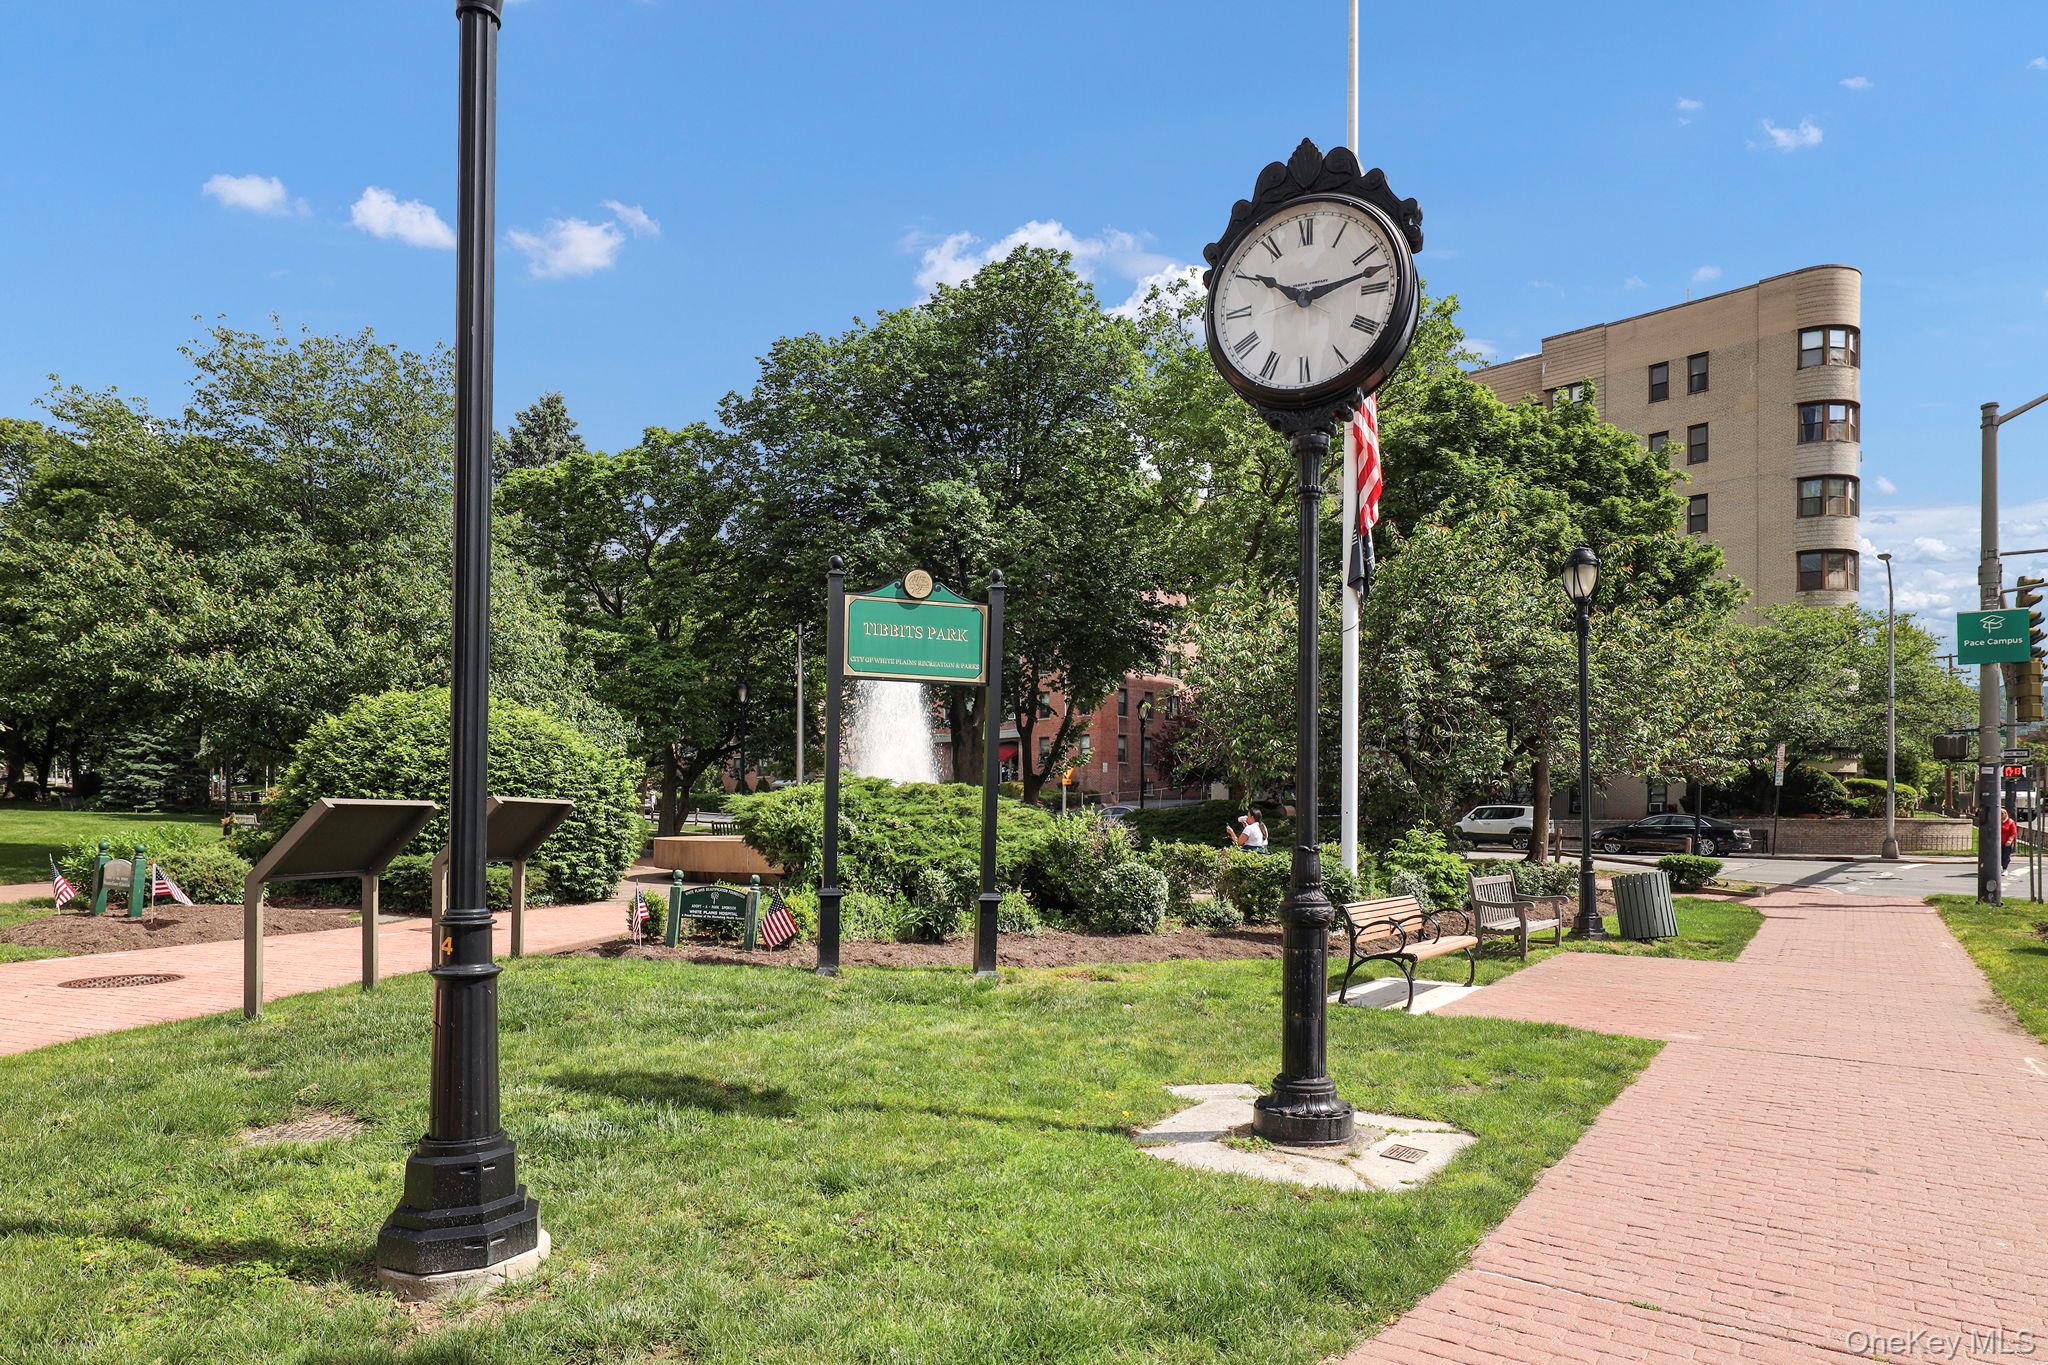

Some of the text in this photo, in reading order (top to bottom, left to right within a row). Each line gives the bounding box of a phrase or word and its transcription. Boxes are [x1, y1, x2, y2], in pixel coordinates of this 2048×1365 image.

[863, 622, 969, 642] TIBBITS PARK
[1987, 637, 2024, 645] Campus
[896, 658, 917, 666] PLAINS
[917, 660, 955, 668] RECREATION
[441, 936, 453, 956] 4
